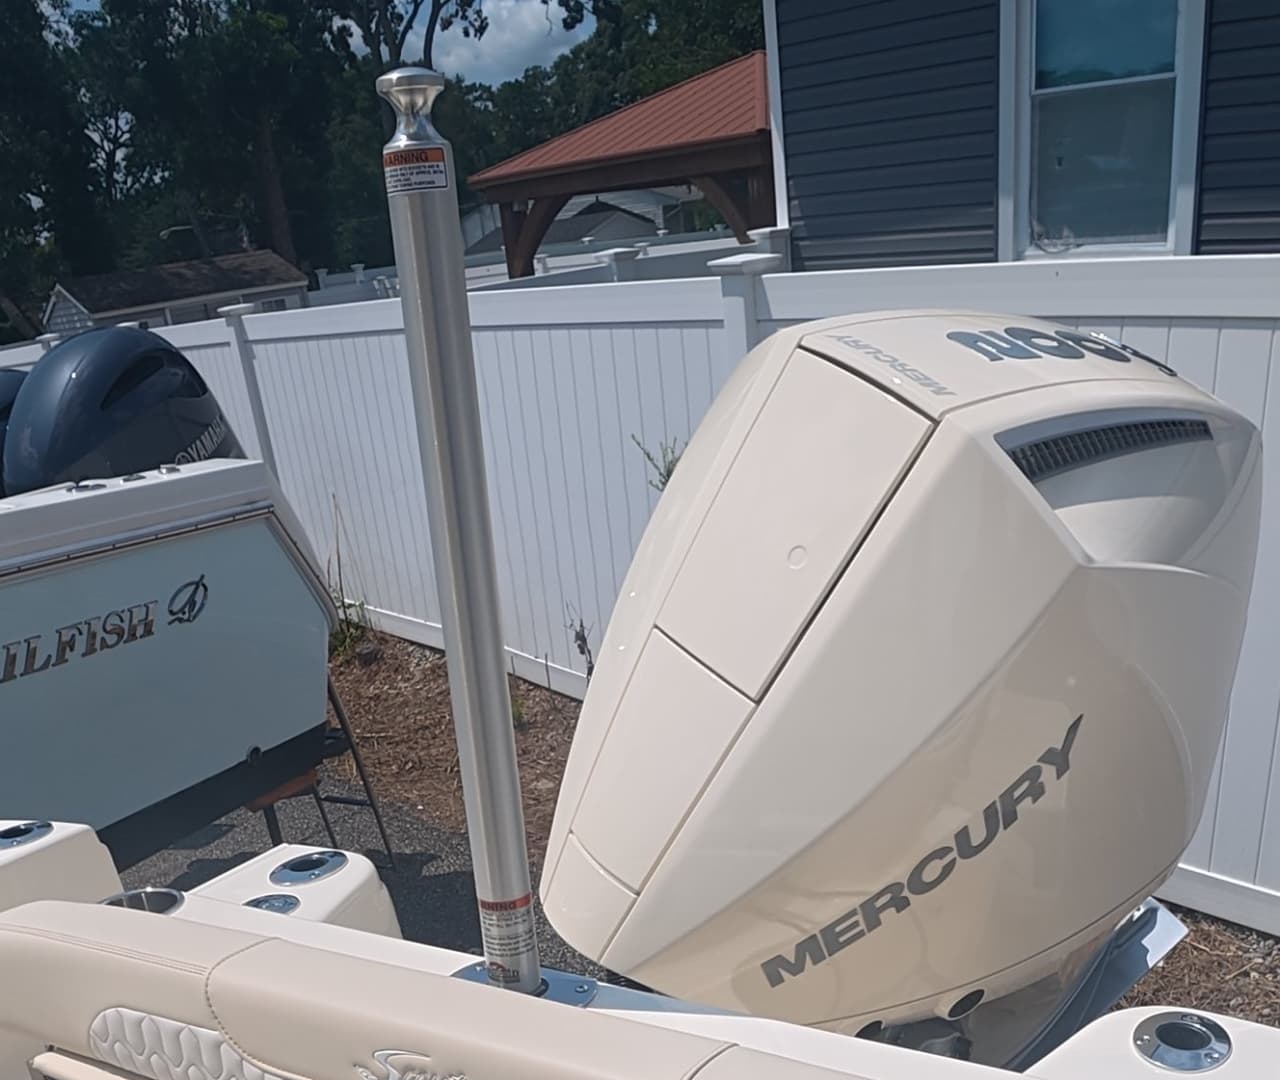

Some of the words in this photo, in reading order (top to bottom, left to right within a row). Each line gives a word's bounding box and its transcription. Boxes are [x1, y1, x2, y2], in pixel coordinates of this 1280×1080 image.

[385, 151, 429, 166] ARNING
[827, 334, 957, 396] MERCURY
[187, 416, 225, 461] YAMAH
[760, 714, 1083, 988] MERCURY
